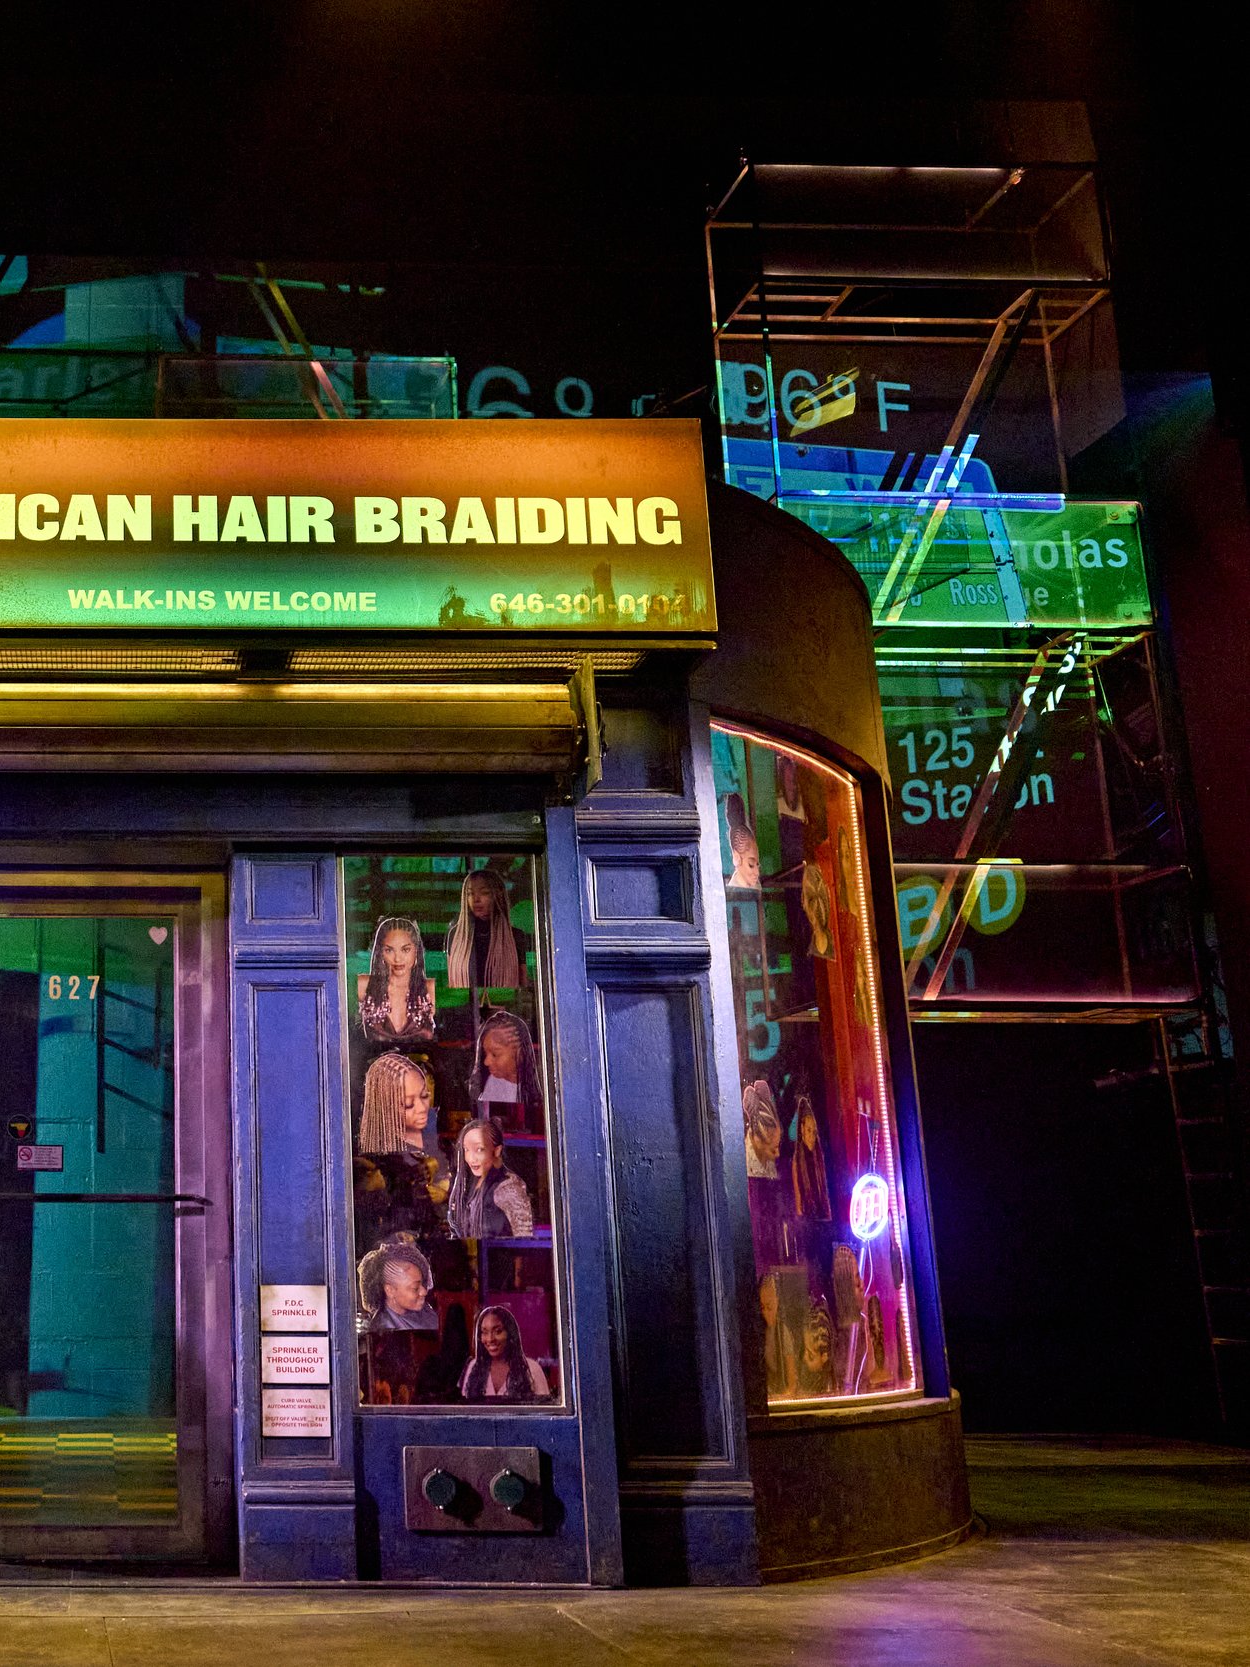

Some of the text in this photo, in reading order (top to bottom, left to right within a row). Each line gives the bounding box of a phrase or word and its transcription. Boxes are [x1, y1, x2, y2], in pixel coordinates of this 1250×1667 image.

[876, 381, 910, 433] F
[173, 494, 336, 545] HAIR
[355, 496, 682, 546] BRAIDING
[68, 588, 377, 613] WALK-INS WELCOME
[950, 579, 999, 607] Ross
[898, 726, 975, 774] 125
[49, 975, 100, 1000] 627
[266, 1356, 325, 1364] THROUGHOUT
[275, 1366, 316, 1374] BUILDING
